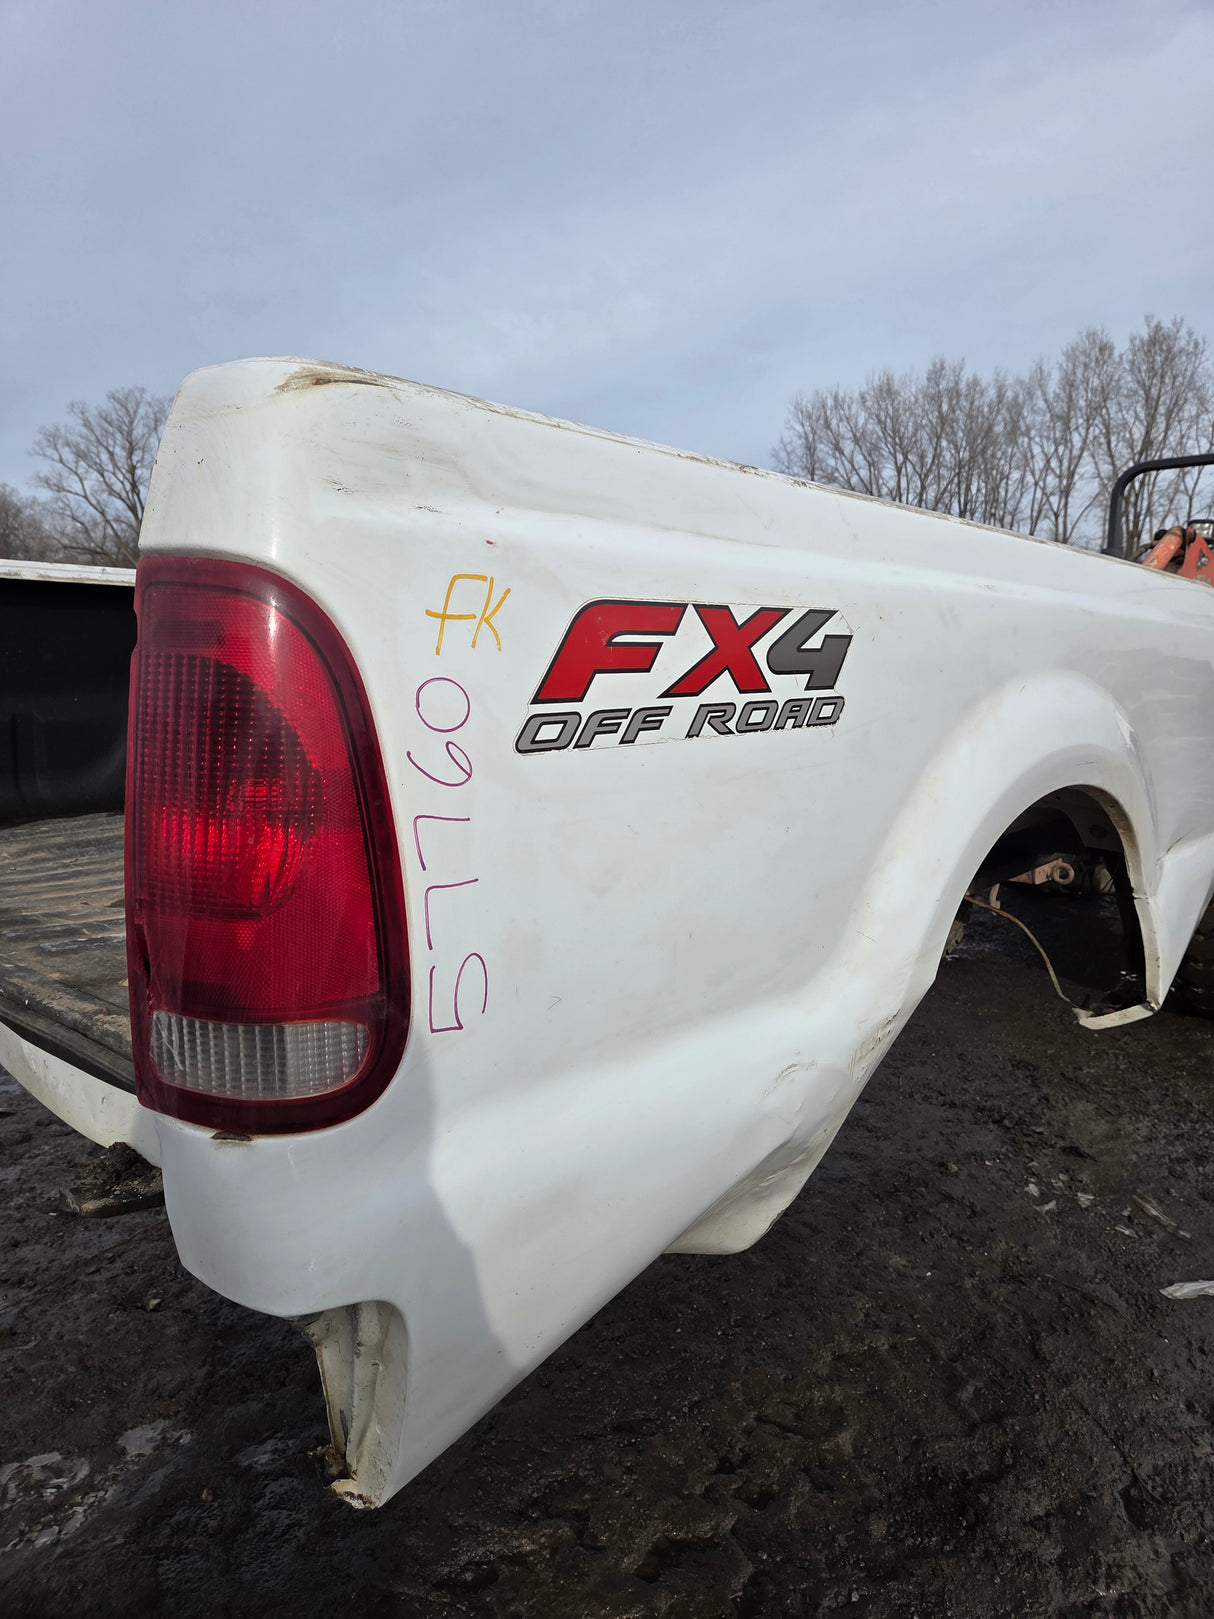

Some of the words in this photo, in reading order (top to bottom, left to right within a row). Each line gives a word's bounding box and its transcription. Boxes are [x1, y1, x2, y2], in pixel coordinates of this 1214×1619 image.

[426, 574, 511, 655] FK
[530, 599, 854, 704] FX4
[514, 705, 673, 754] OFF
[685, 696, 845, 739] ROAD
[406, 677, 488, 1033] 57760
